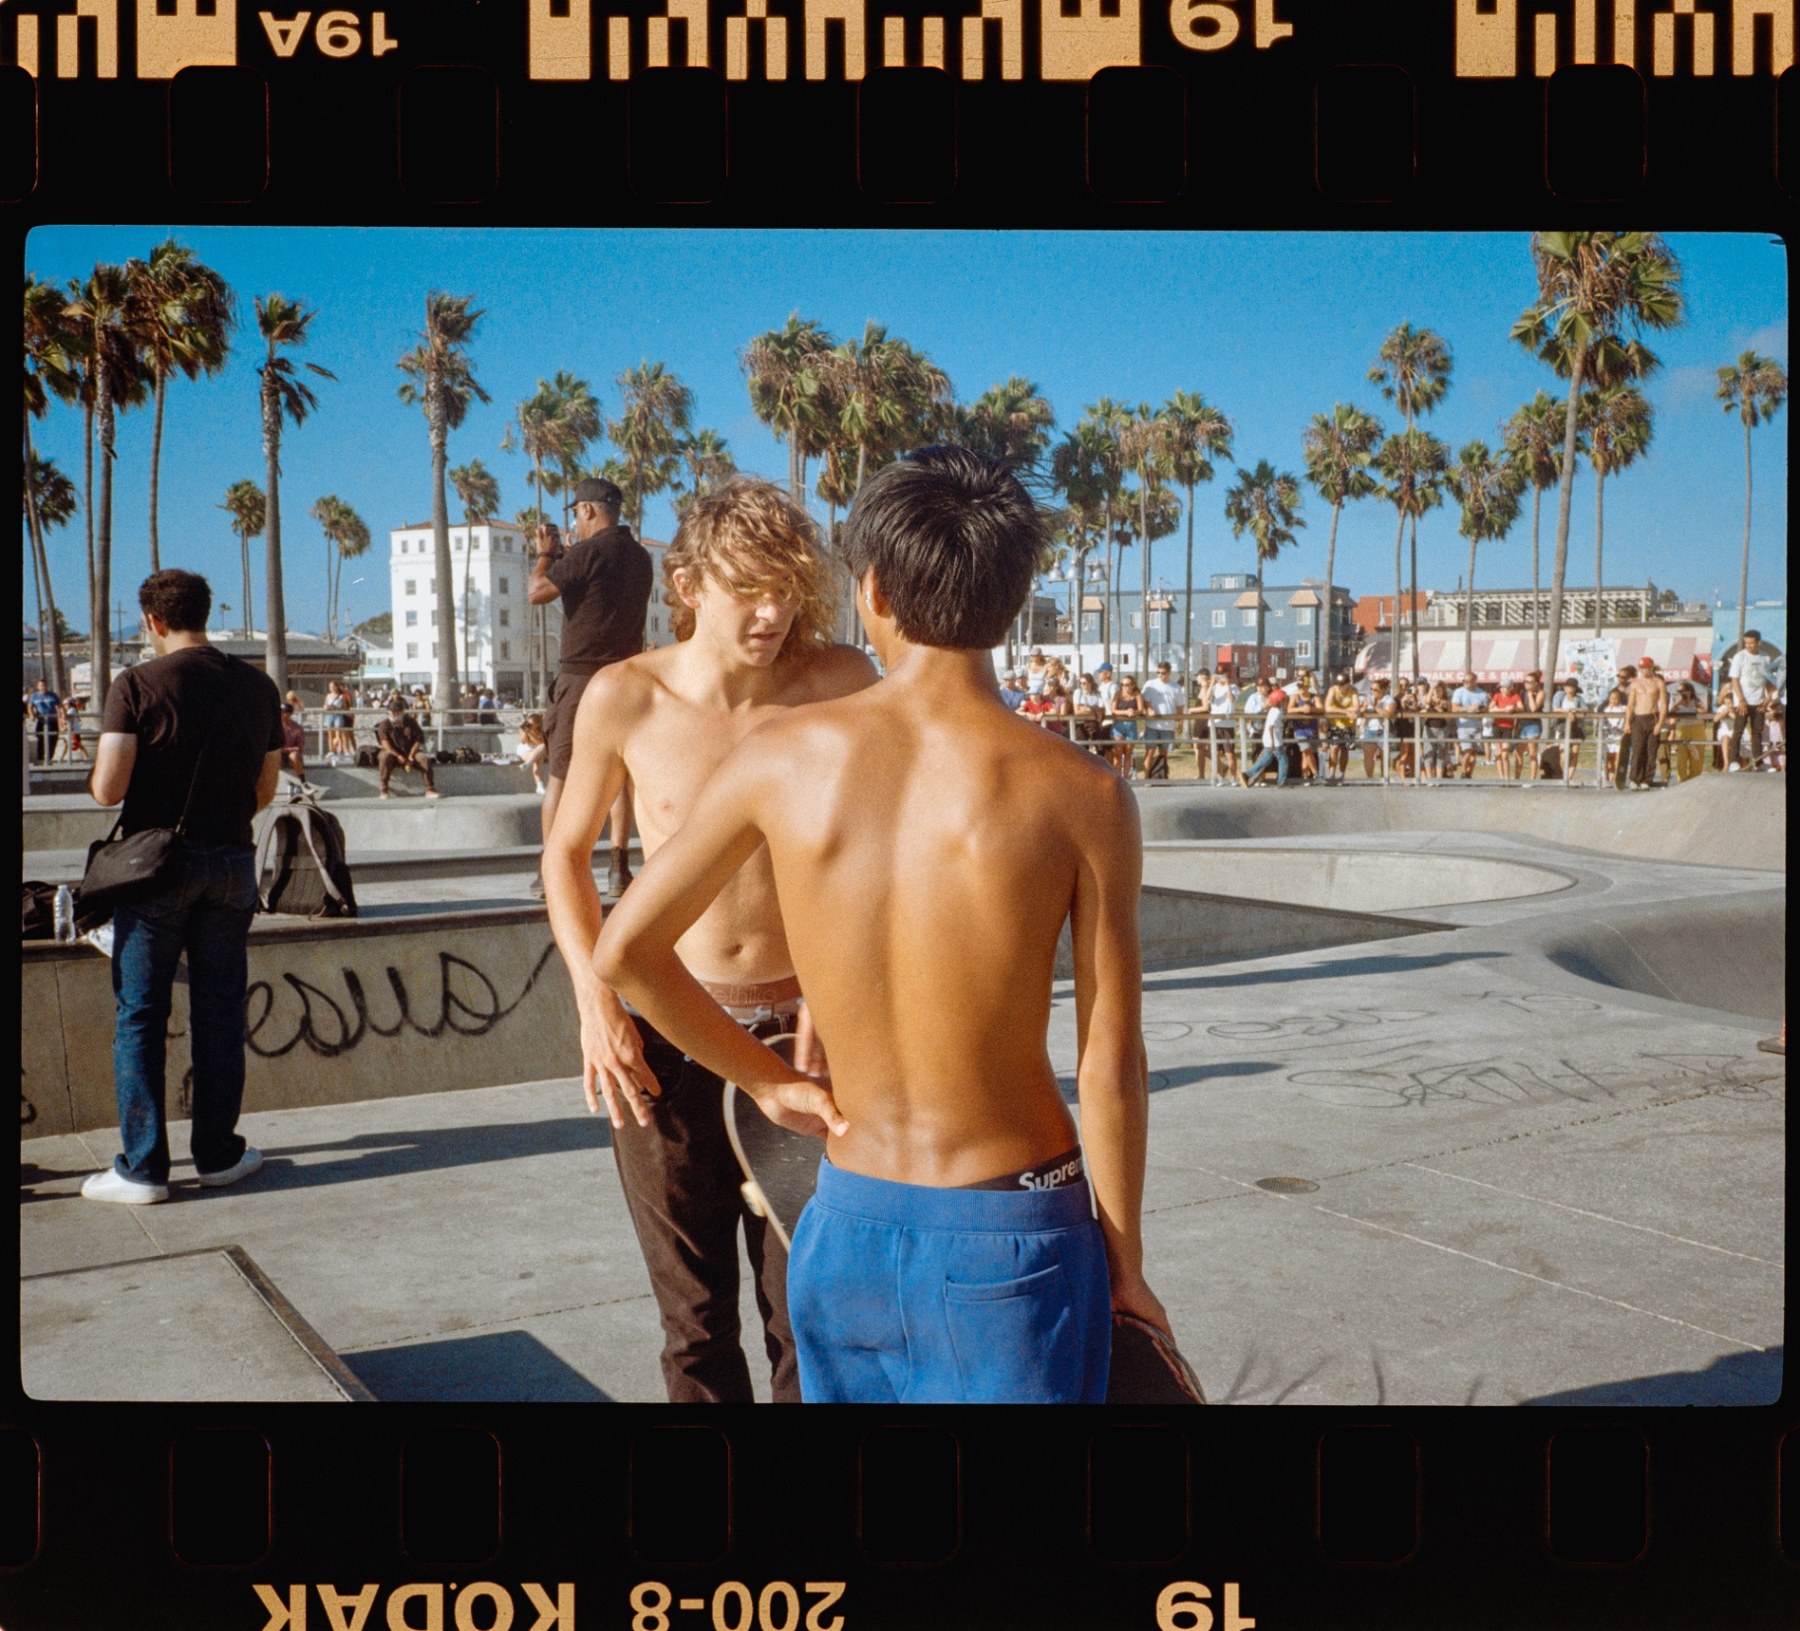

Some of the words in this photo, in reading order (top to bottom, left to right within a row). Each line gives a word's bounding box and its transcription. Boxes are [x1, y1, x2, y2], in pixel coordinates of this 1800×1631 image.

[257, 10, 398, 57] 19A
[1170, 0, 1293, 50] 19
[243, 942, 557, 1058] esus
[251, 1581, 575, 1631] KODAK
[629, 1580, 847, 1631] 200-8
[1155, 1580, 1256, 1631] 19
